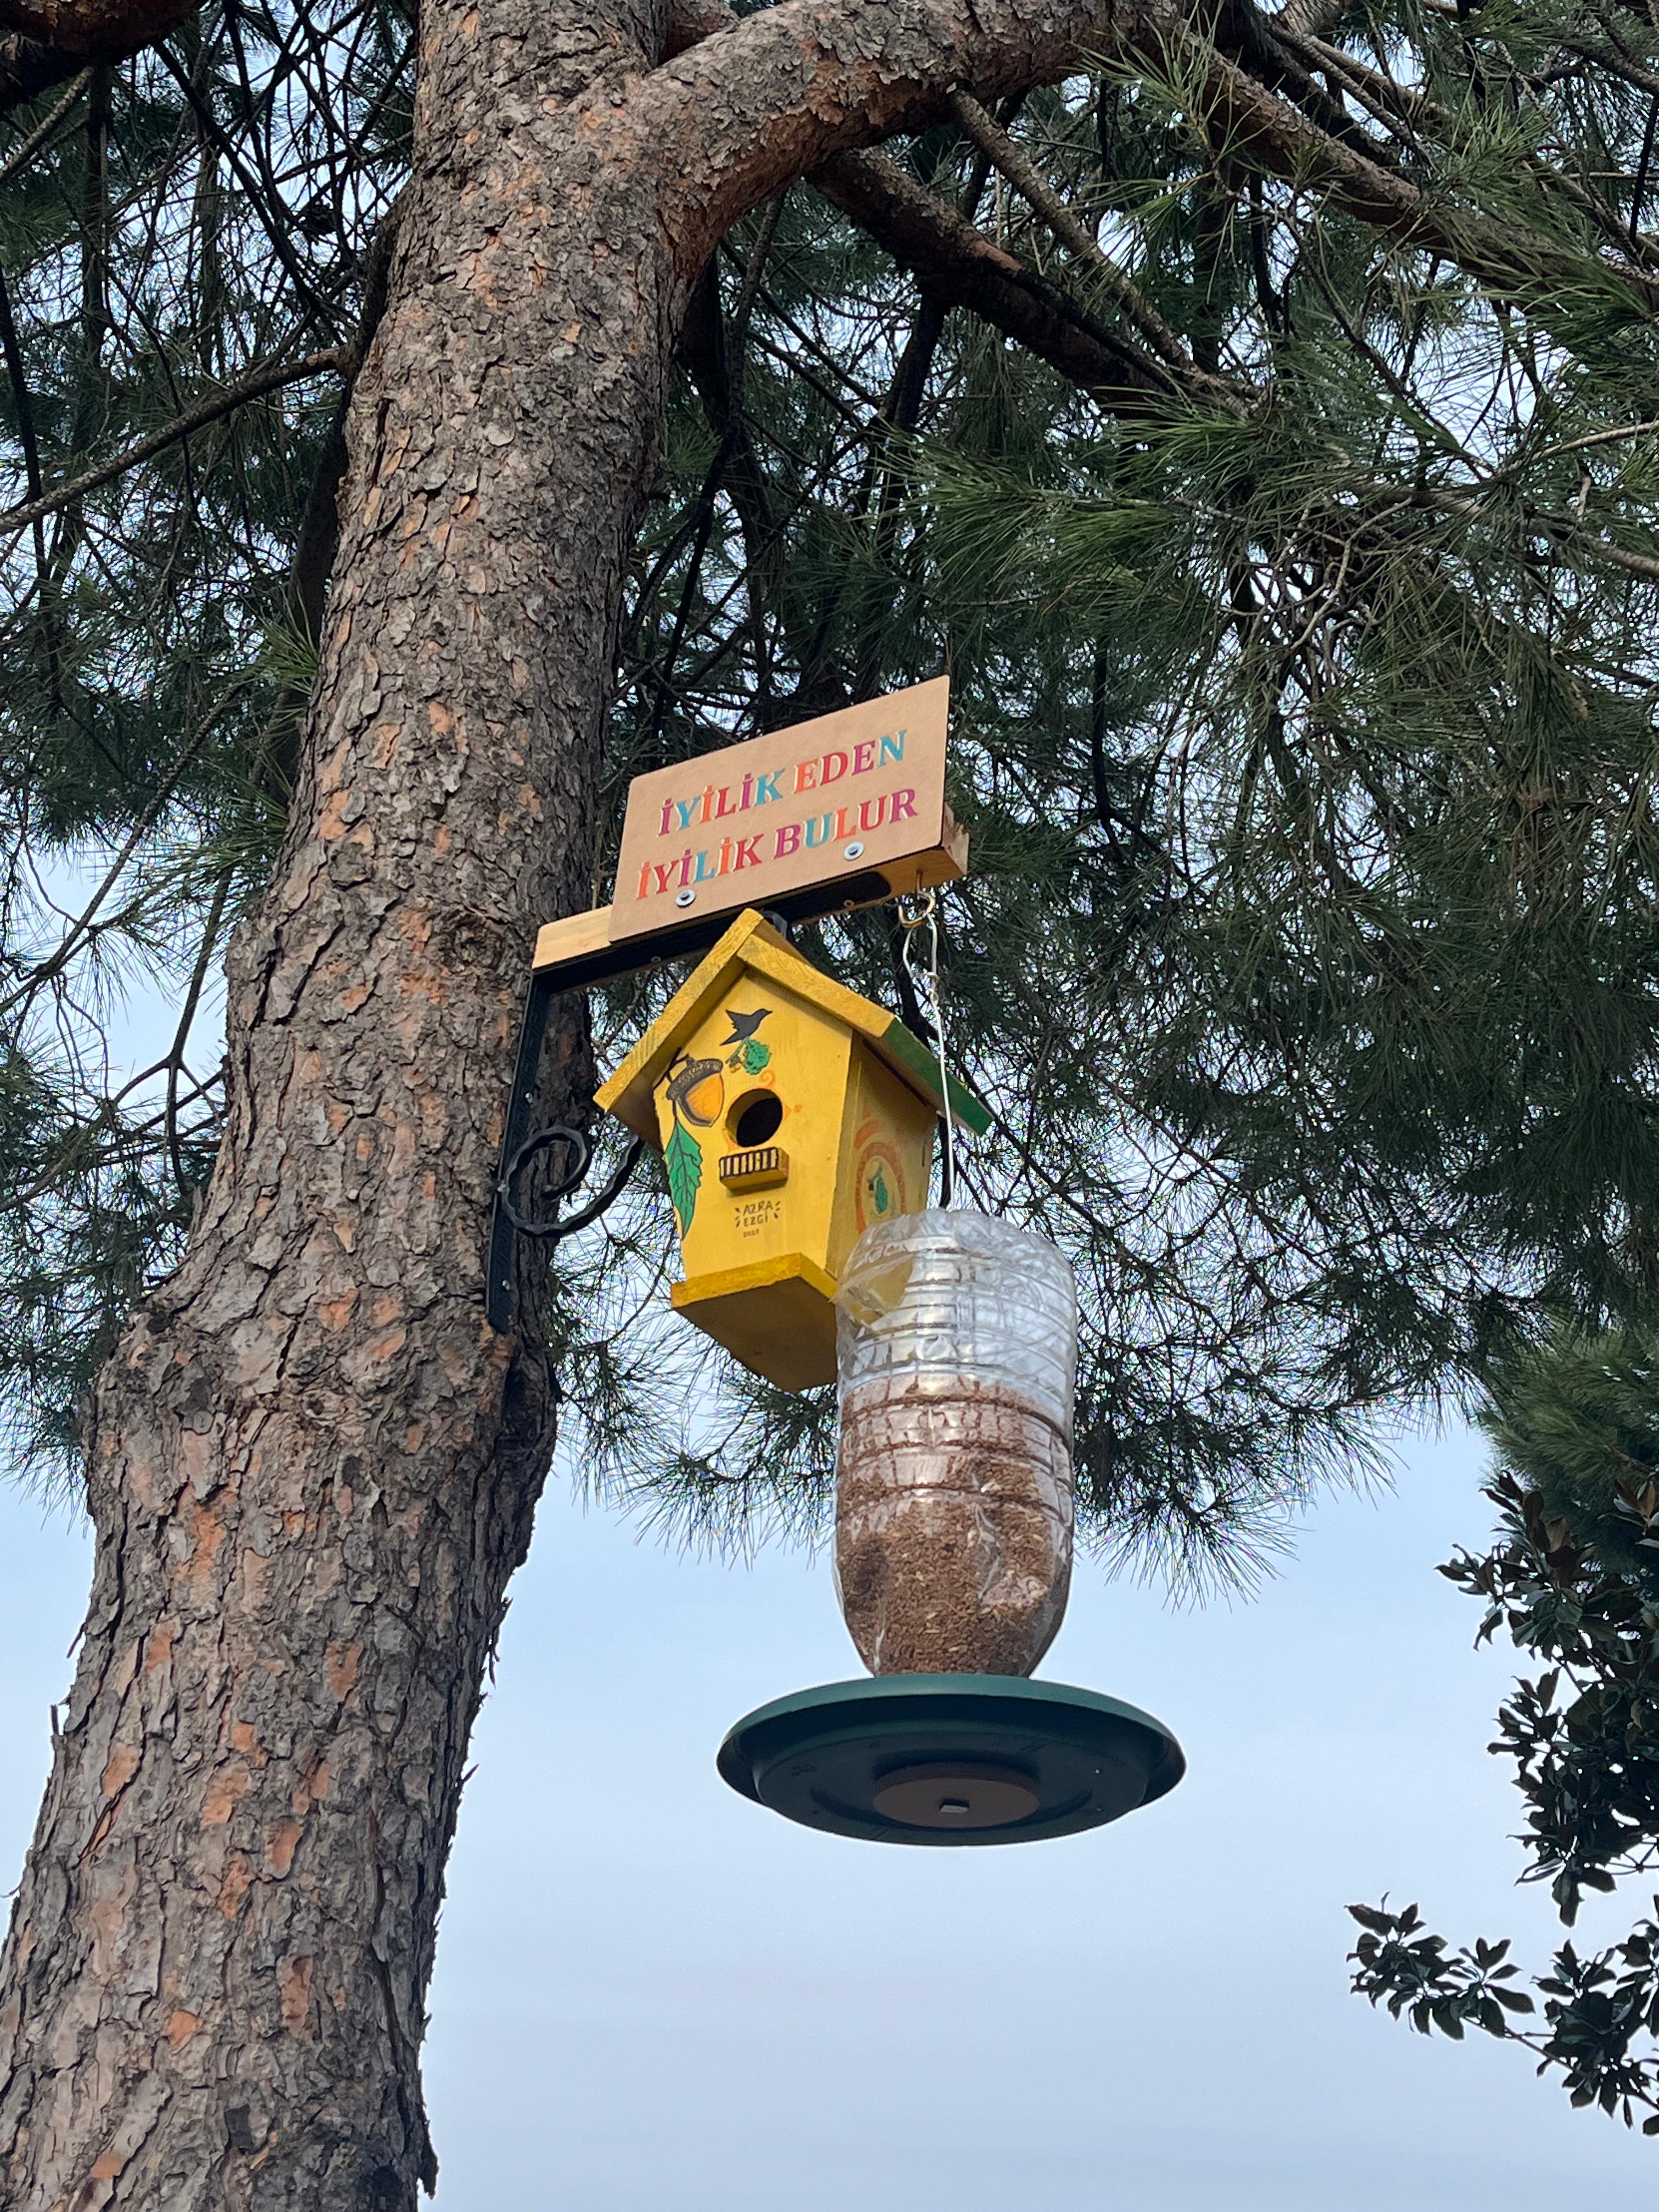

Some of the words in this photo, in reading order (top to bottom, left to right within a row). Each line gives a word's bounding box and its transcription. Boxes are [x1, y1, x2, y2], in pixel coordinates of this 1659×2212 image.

[658, 769, 786, 837] İYİLİK
[794, 730, 907, 795] EDEN
[636, 834, 764, 900] İYİLİK
[774, 788, 918, 860] BULUR
[743, 1200, 774, 1216] AZRA
